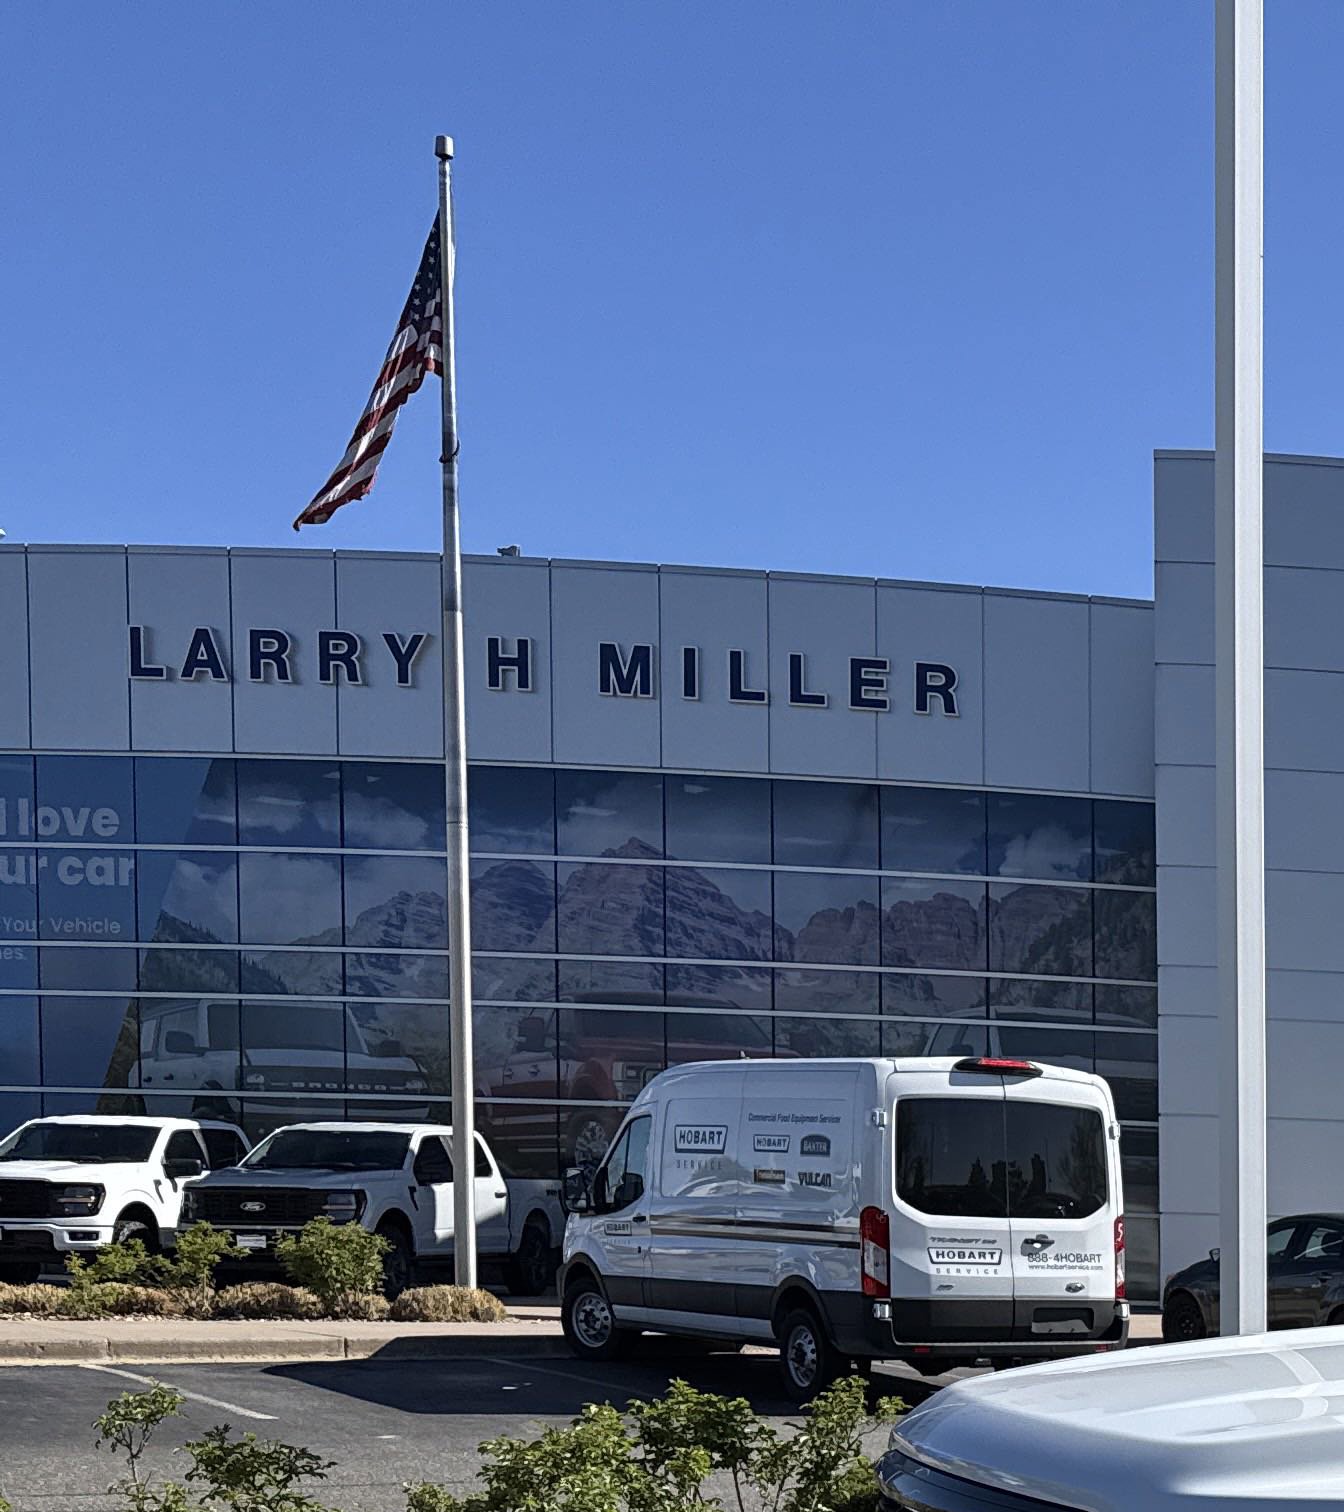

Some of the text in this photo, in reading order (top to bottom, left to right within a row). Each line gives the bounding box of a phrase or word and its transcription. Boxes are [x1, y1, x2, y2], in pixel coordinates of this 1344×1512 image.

[127, 624, 960, 718] LARRY H MILLER
[17, 797, 120, 837] love
[57, 856, 134, 886] car
[50, 917, 121, 935] Vehicle
[678, 1130, 723, 1145] HOBART
[756, 1137, 788, 1148] HOBART
[677, 1159, 722, 1170] SERVICE
[936, 1250, 997, 1260] HOBART
[1027, 1252, 1103, 1264] 888-4HOBART
